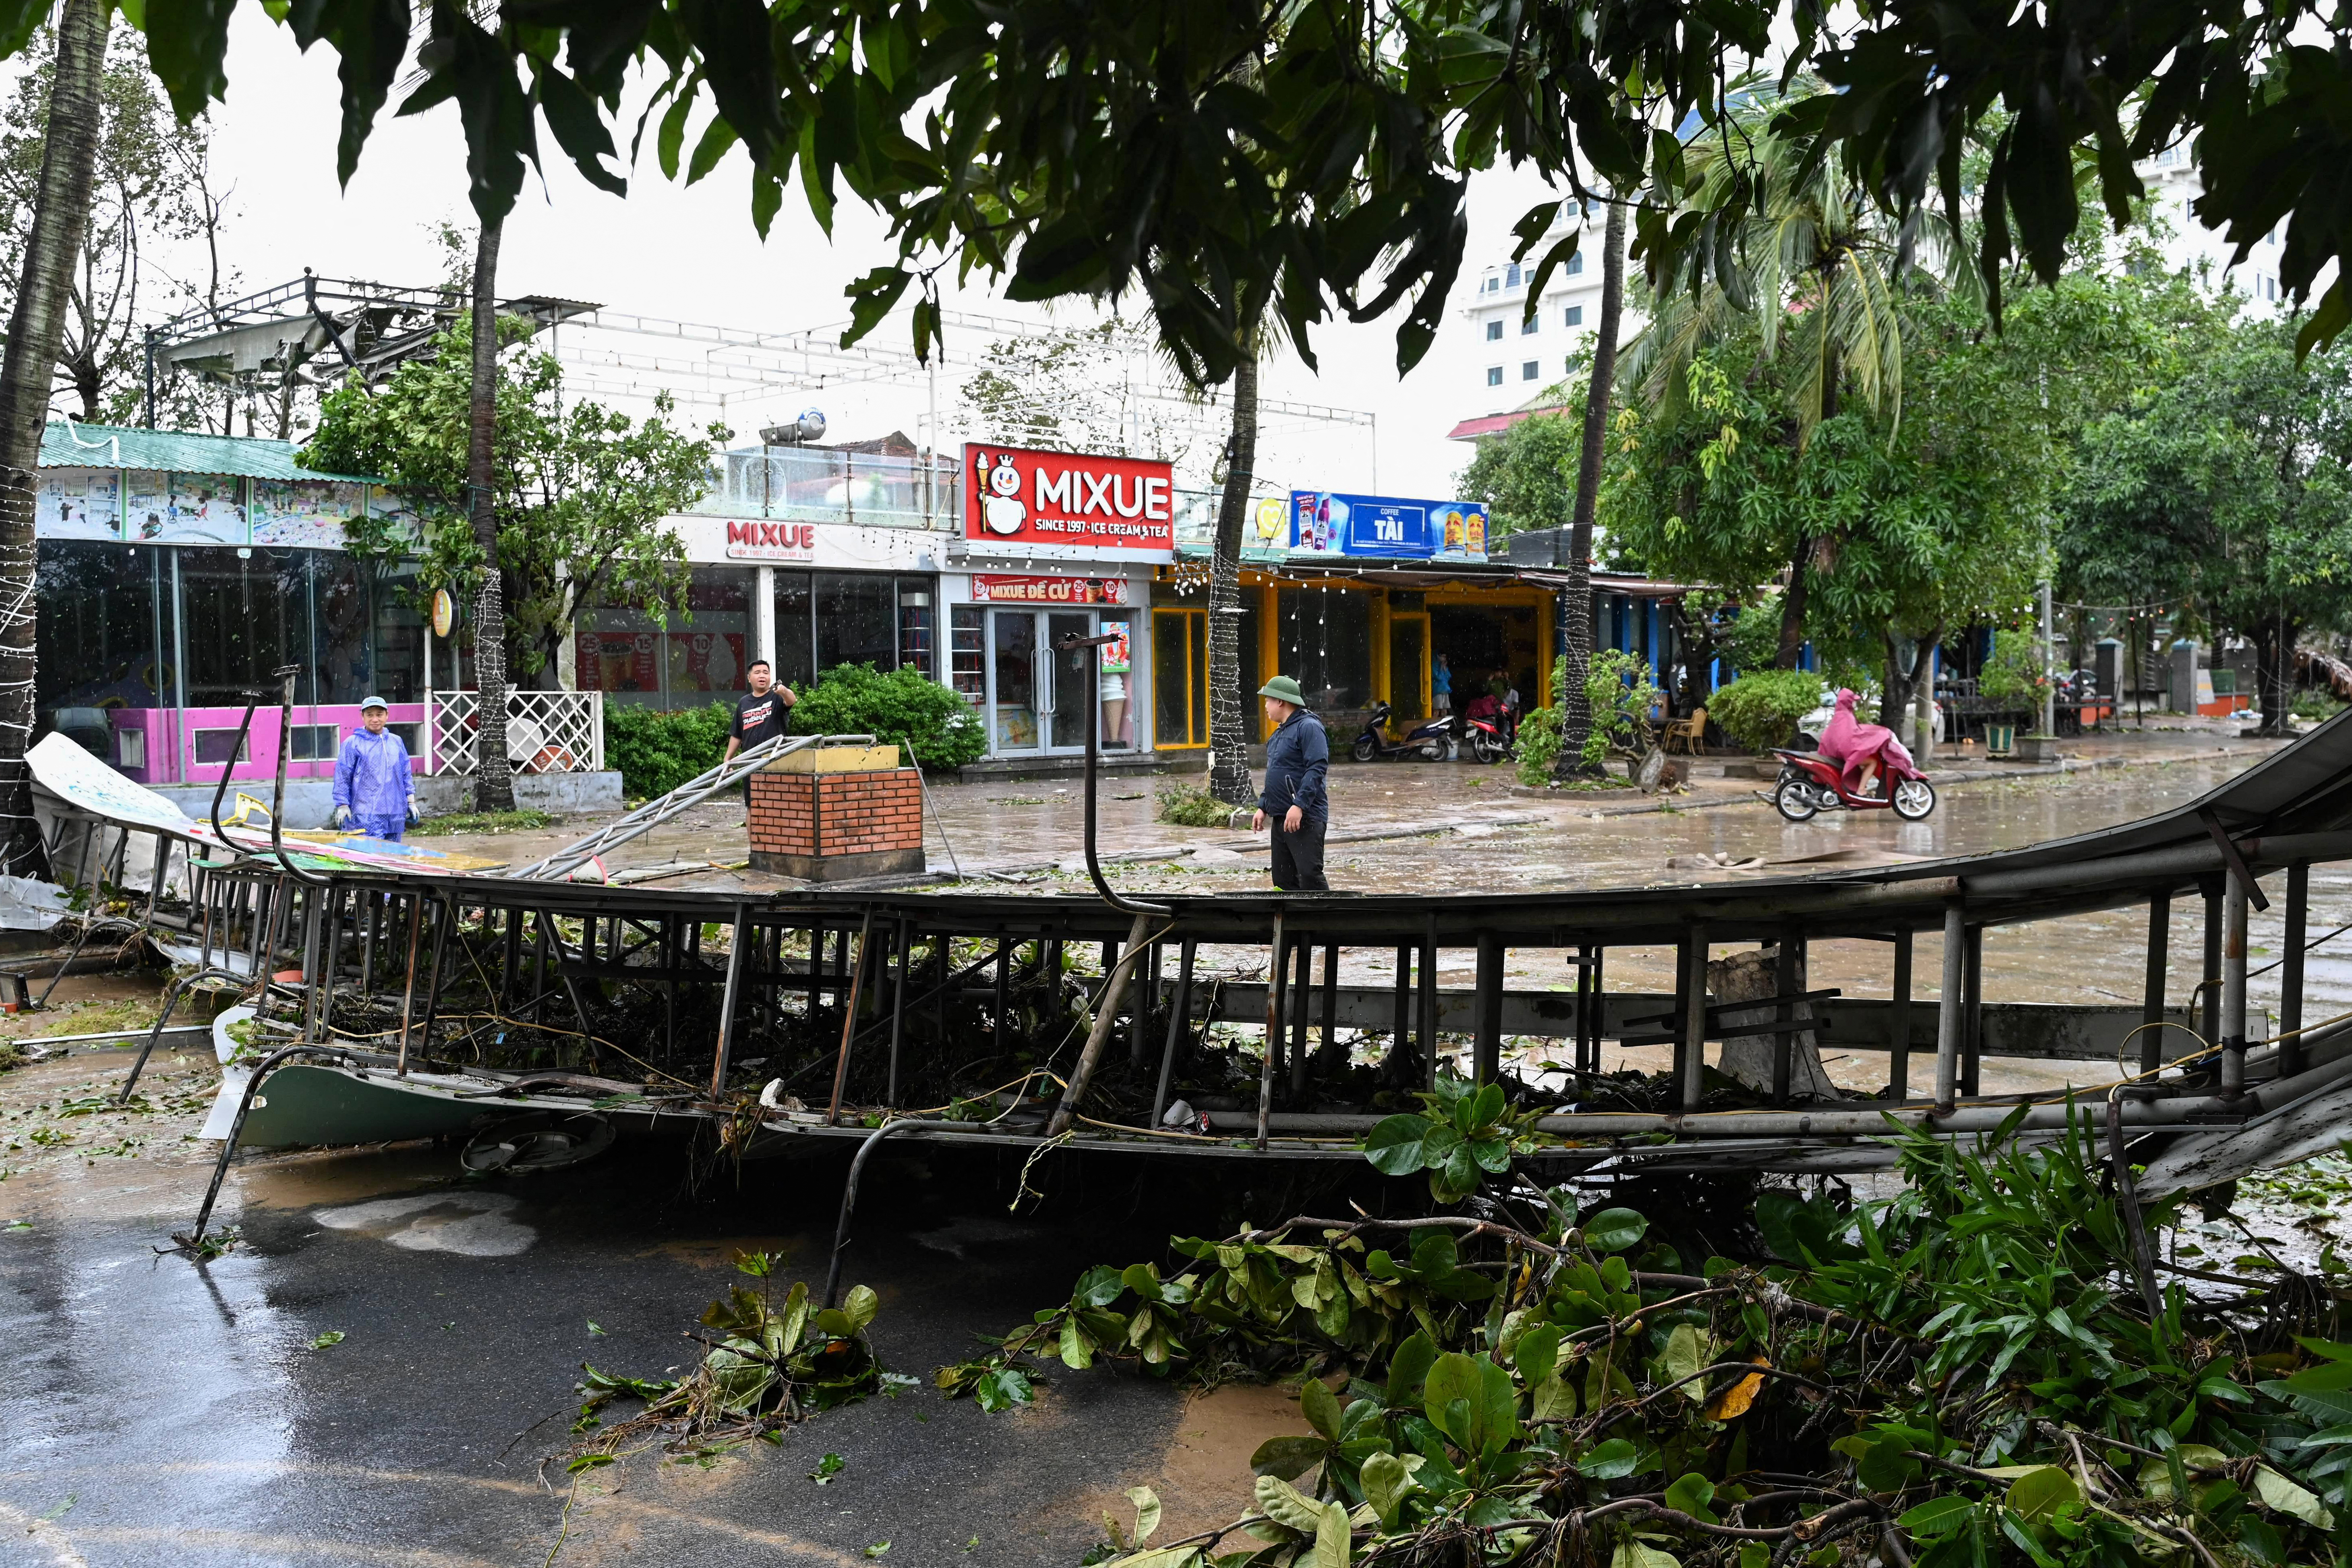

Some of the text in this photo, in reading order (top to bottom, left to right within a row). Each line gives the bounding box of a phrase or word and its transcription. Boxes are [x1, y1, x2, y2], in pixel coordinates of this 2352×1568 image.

[1036, 467, 1168, 520] MIXUE
[727, 521, 815, 548] MIXUE
[1035, 519, 1064, 531] SINCE
[1067, 520, 1086, 533] 1997
[1091, 522, 1106, 534] ICE
[1375, 516, 1403, 541] TÀI
[990, 585, 1026, 599] MIXUE
[1048, 579, 1072, 600] CỬ
